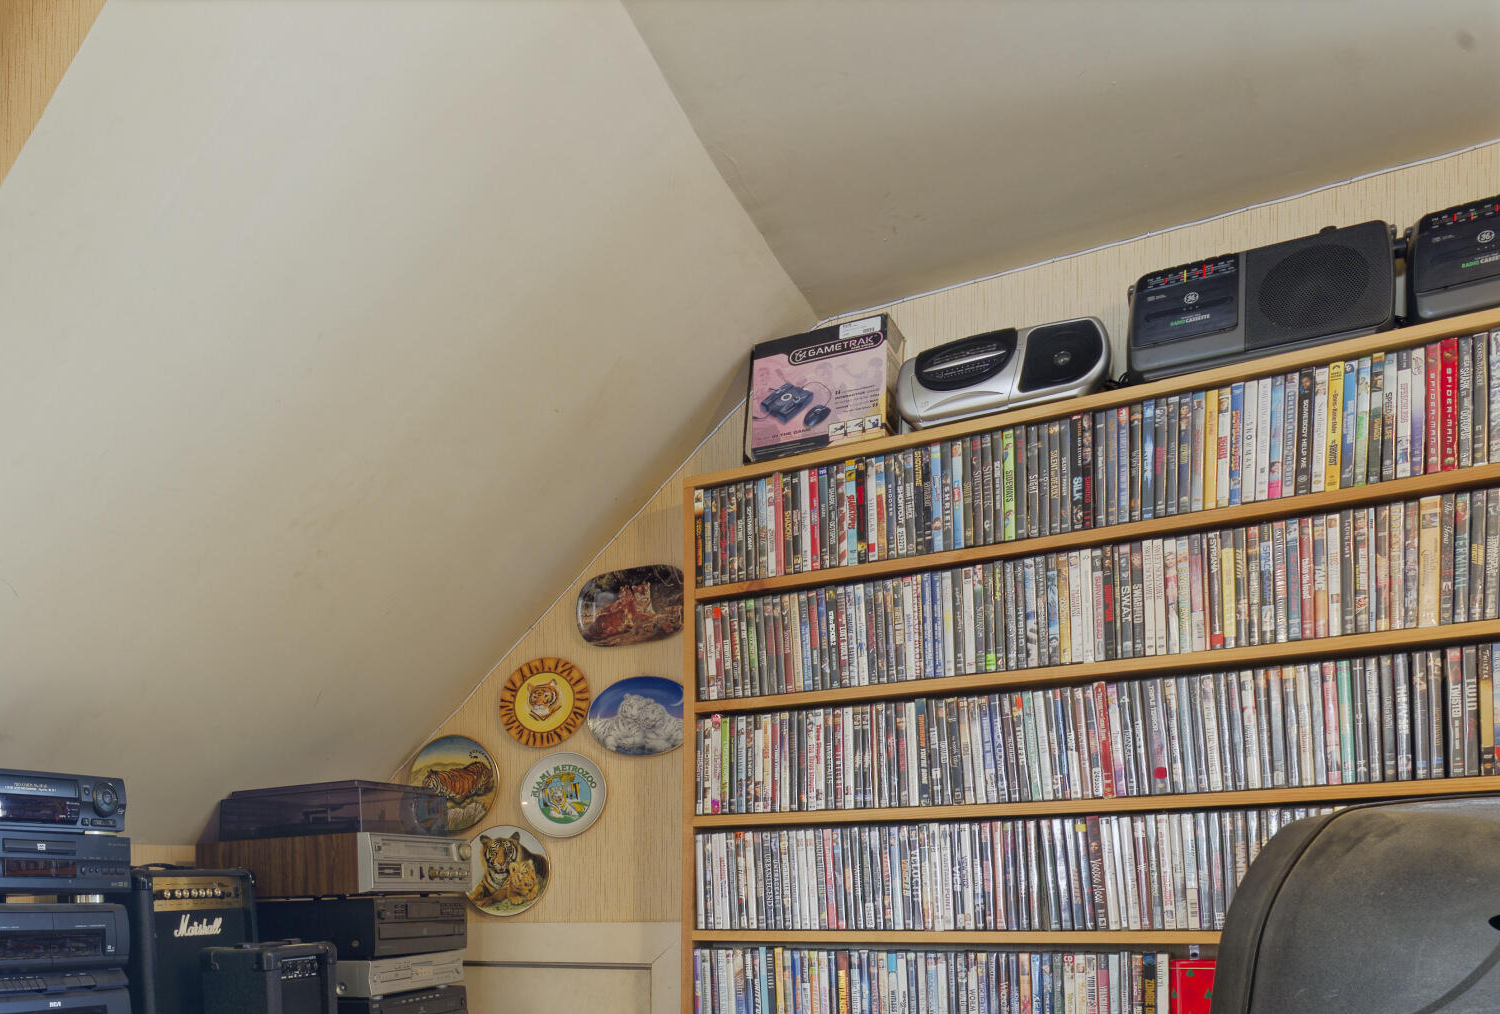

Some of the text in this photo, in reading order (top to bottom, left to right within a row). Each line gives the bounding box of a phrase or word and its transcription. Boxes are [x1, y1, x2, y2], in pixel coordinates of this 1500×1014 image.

[1185, 313, 1211, 323] CASSETTE
[808, 334, 874, 357] GAMETRAK
[1460, 367, 1468, 389] SHARK
[1300, 457, 1306, 468] ME
[1005, 470, 1013, 502] SIDEWAYS
[1072, 476, 1082, 499] SILK
[1209, 538, 1218, 573] SYRIANA
[1454, 533, 1467, 588] TERMINAL
[1121, 585, 1130, 622] S.W.A.T.
[1147, 685, 1155, 706] TRIPLE
[1451, 683, 1461, 717] TWISTED
[531, 764, 597, 798] MIAMI METROZOO
[173, 913, 223, 937] Marshall
[1145, 978, 1154, 1006] ZOMBIE
